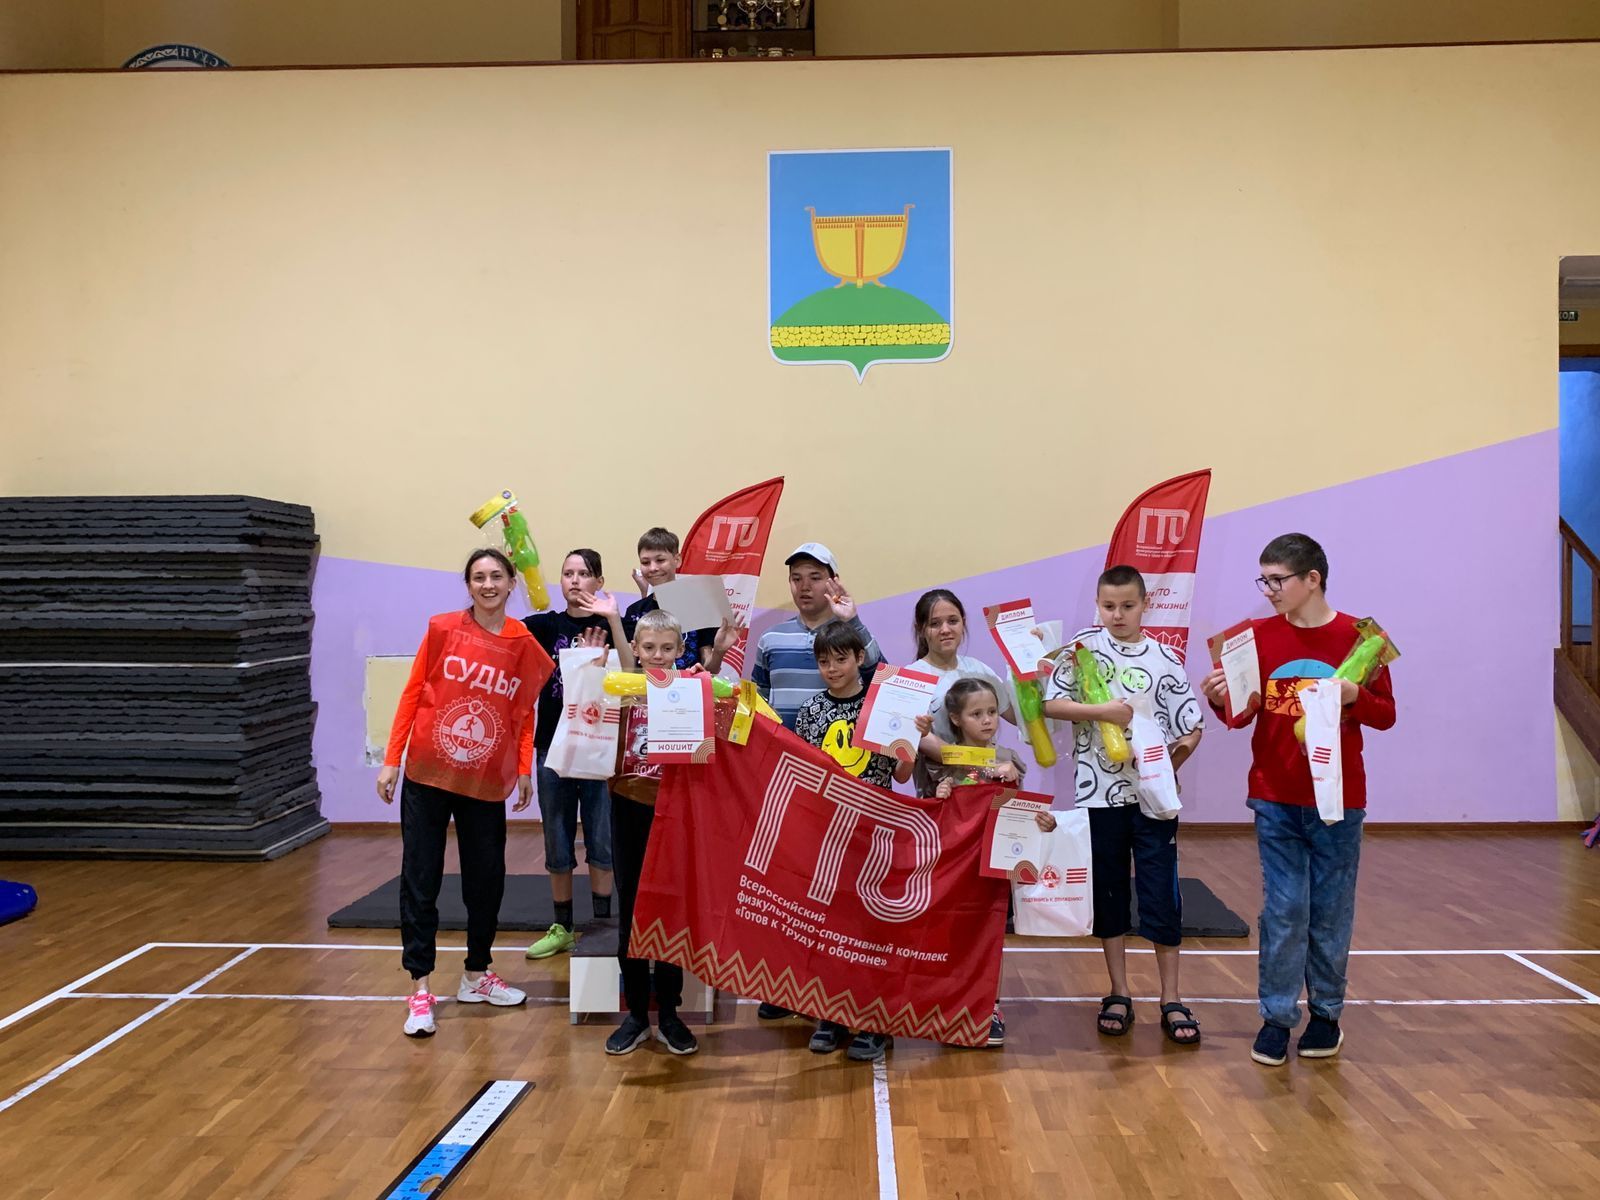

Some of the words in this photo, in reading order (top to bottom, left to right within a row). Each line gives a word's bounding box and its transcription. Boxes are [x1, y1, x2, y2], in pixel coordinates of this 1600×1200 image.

[181, 47, 221, 68] СТАН
[707, 515, 760, 551] ГТО
[1136, 507, 1191, 545] ГТО
[1155, 588, 1171, 597] ГТО
[730, 603, 750, 611] зни!
[1155, 602, 1189, 610] жизни!
[443, 655, 522, 701] СУДЬЯ
[892, 677, 926, 689] ДИПЛОМ
[632, 708, 648, 719] HIS
[457, 737, 474, 748] ГТО
[657, 743, 694, 752] ДИПЛОМ
[1011, 800, 1042, 810] ДИПЛОМ
[744, 751, 942, 923] ГТО
[739, 874, 827, 924] Всероссийский
[737, 890, 894, 955] физкультурно-спортивный
[895, 947, 949, 962] комплекс
[735, 906, 769, 926] «Готов
[770, 919, 779, 929] к
[781, 923, 816, 949] труду
[816, 942, 826, 952] и
[828, 945, 888, 967] обороне»
